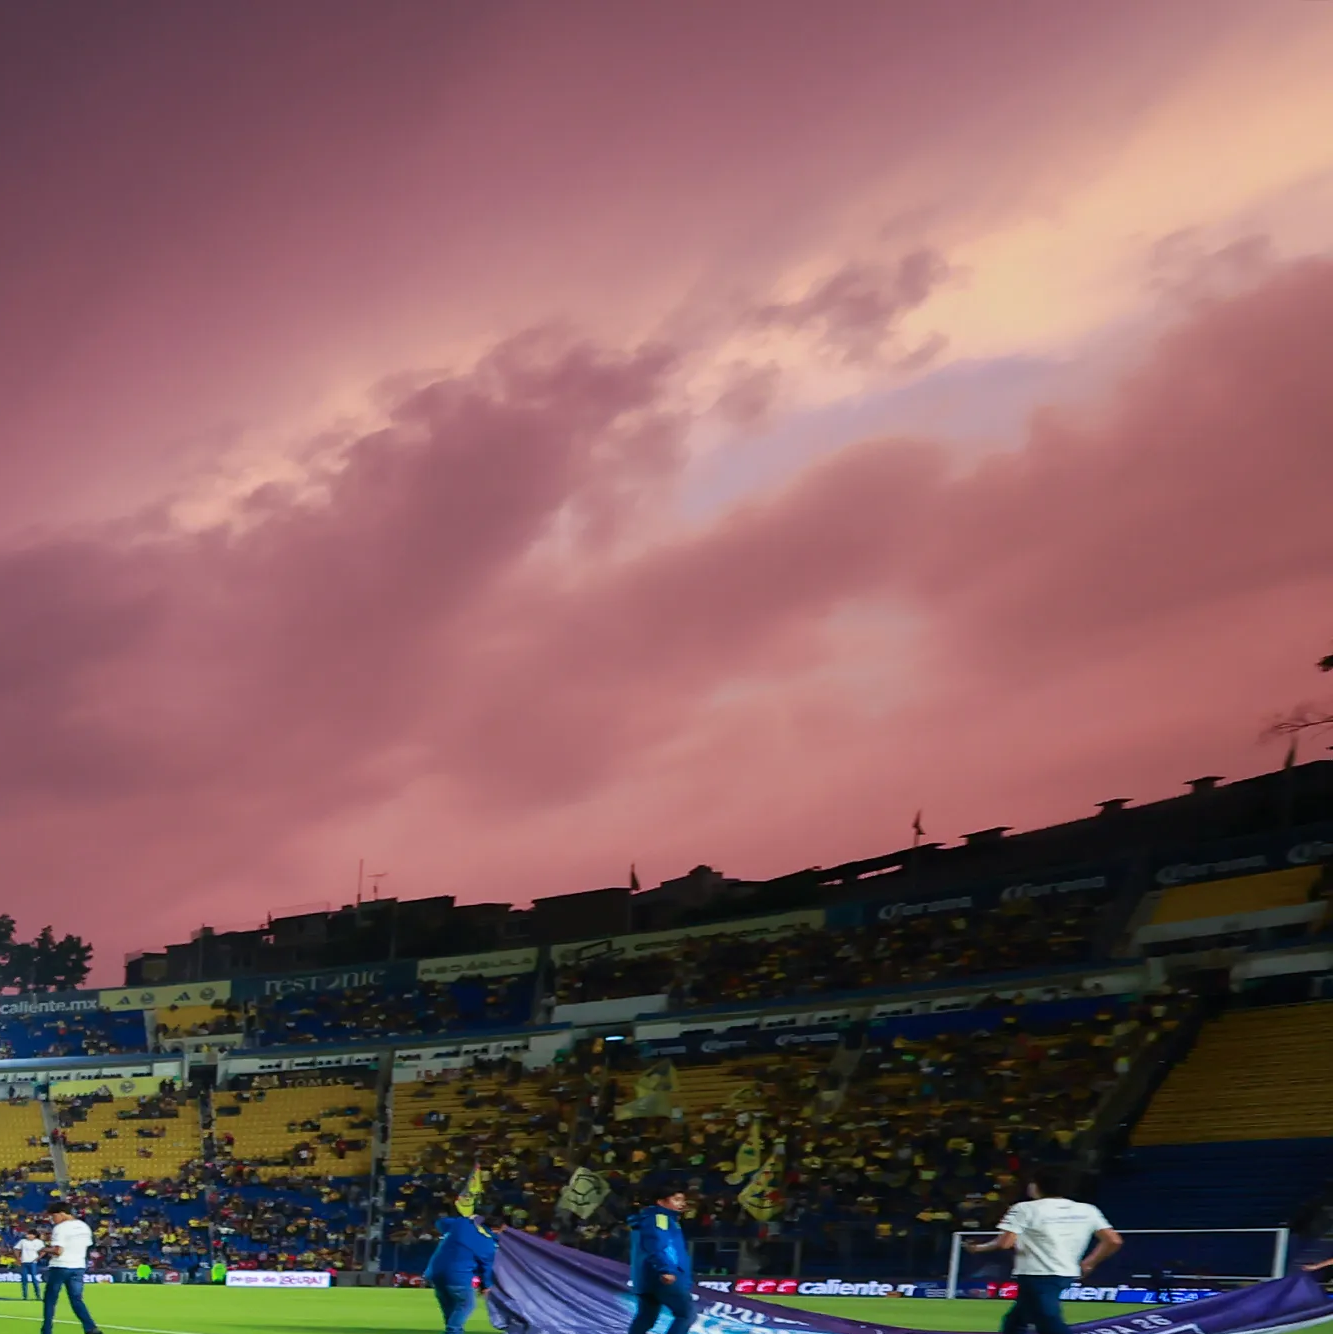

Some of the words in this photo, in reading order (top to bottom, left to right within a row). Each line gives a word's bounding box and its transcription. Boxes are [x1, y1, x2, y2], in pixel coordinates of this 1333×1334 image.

[0, 999, 99, 1016] caliente.mx
[83, 1274, 114, 1283] eren
[1132, 1314, 1173, 1331] 26
